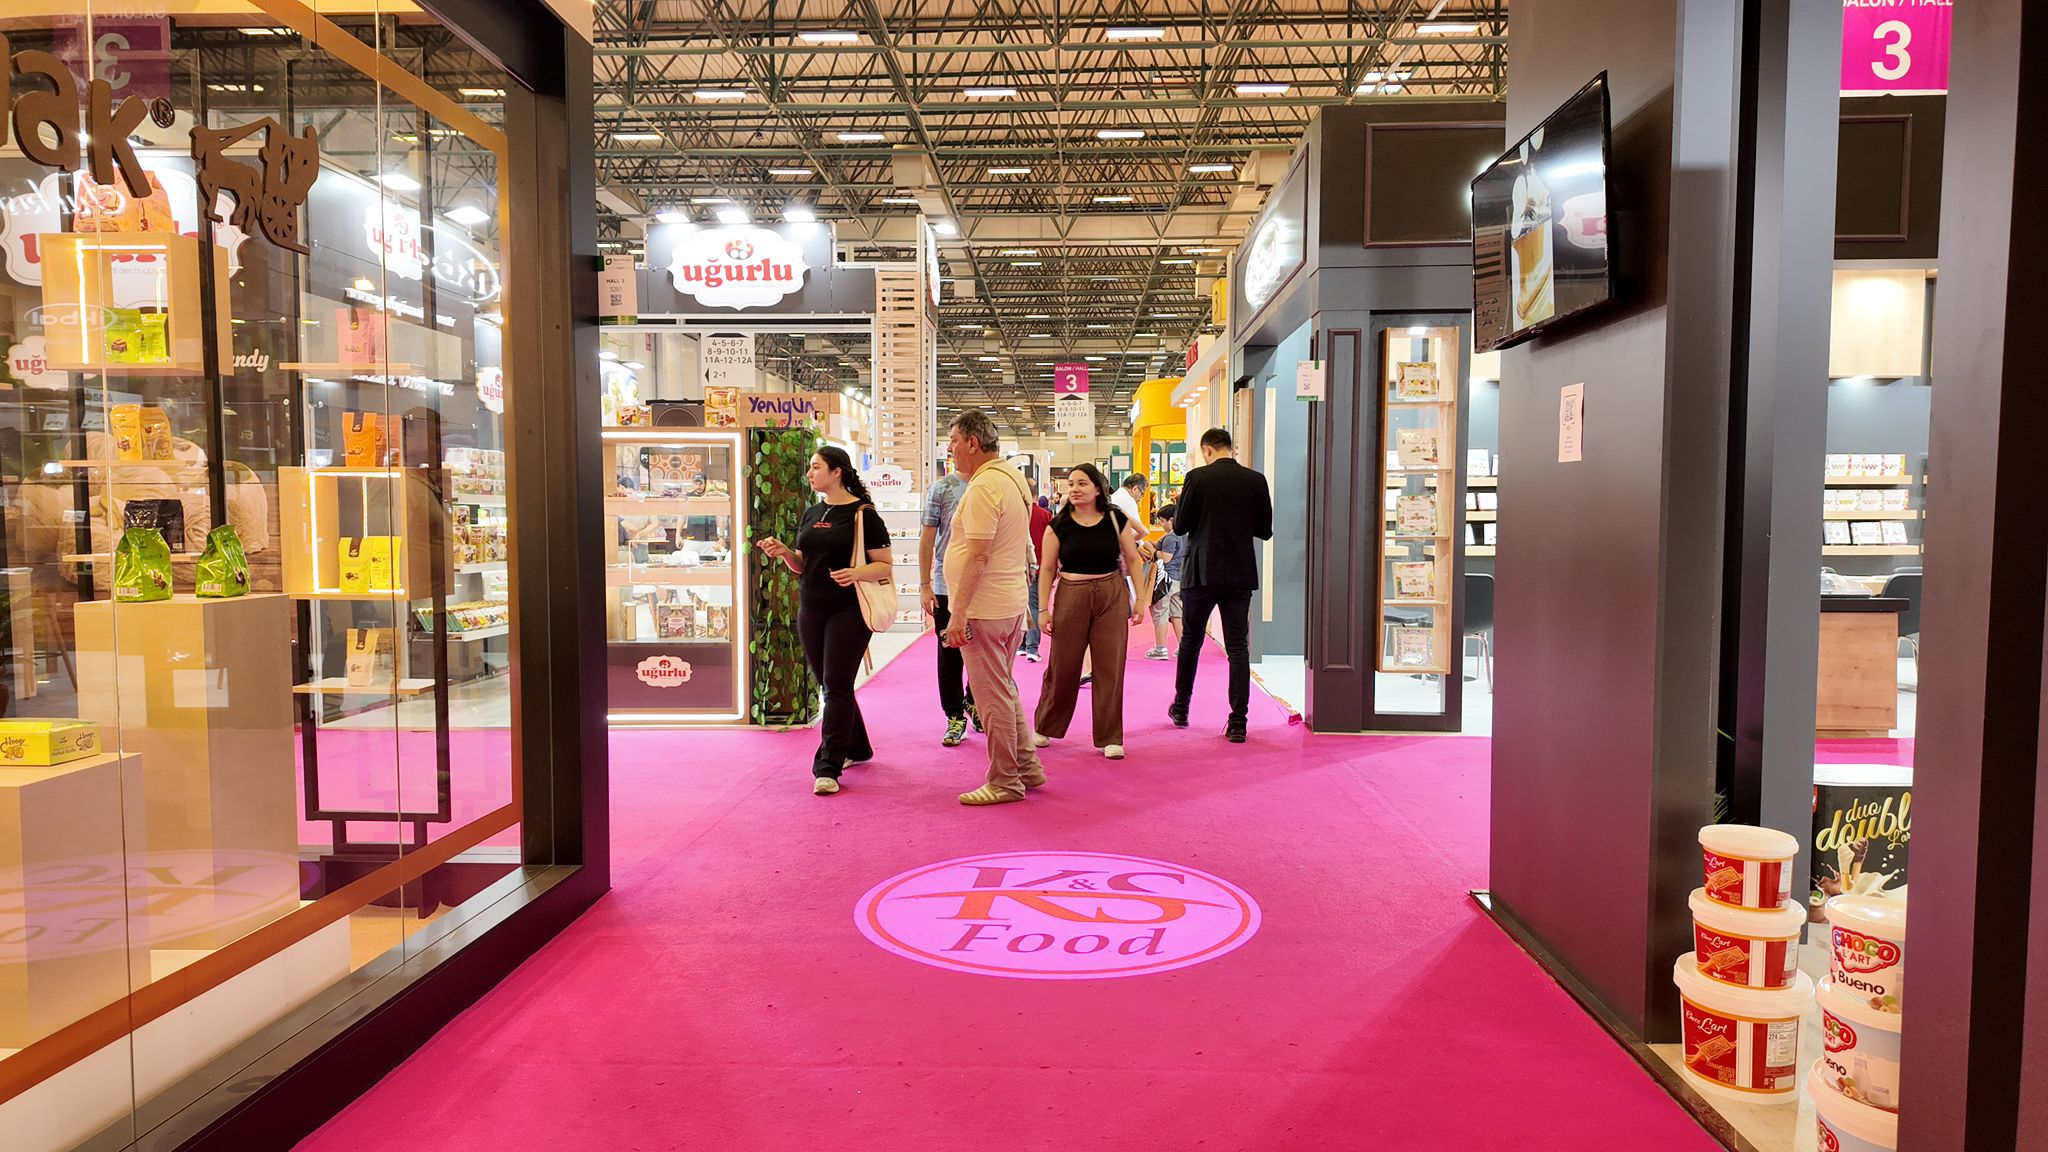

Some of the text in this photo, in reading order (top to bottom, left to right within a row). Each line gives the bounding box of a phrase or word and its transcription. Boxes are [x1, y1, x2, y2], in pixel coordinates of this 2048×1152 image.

[1871, 20, 1912, 80] 3
[682, 258, 793, 287] uğurlu
[707, 347, 748, 355] 8-9-10-11
[712, 339, 744, 347] 4-5-6-7
[233, 348, 269, 373] ndy
[704, 356, 753, 364] 11A-12-12A
[713, 371, 726, 379] 2-1
[1065, 374, 1078, 391] 3
[642, 668, 687, 679] uğurlu
[1845, 798, 1881, 823] duo
[936, 865, 1187, 924] K&S
[940, 923, 1167, 956] Food
[1834, 930, 1894, 962] CHOCO
[1838, 970, 1885, 996] Bueno
